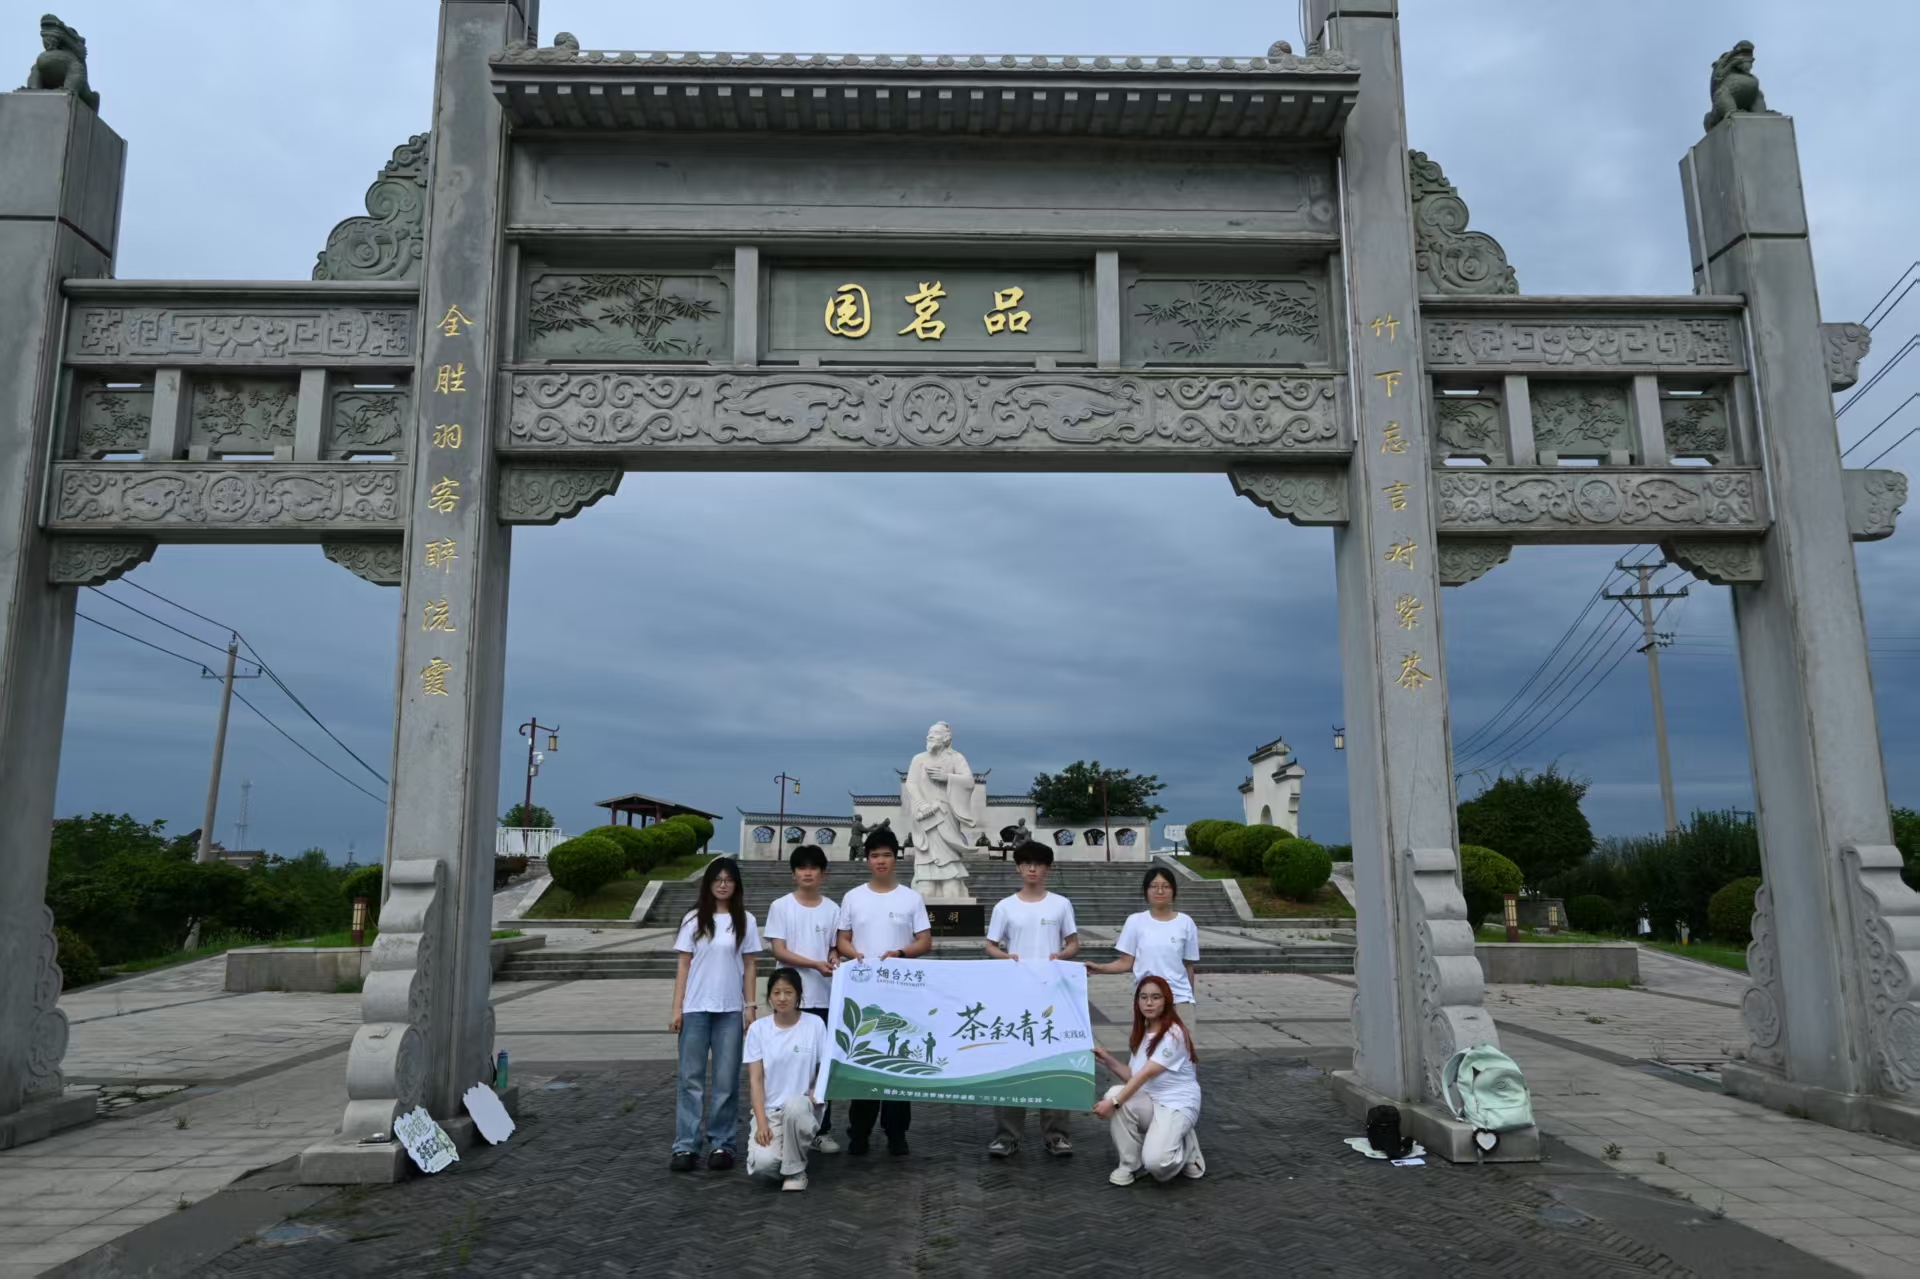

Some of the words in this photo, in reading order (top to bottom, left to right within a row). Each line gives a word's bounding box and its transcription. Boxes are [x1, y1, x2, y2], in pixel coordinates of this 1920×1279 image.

[825, 281, 1032, 340] 品茗园
[419, 304, 474, 697] 全胜羽客醉流霞
[1369, 312, 1433, 692] 竹下忘言对紫茶
[876, 966, 925, 982] 烟台大学
[950, 1002, 1060, 1047] 茶叙青禾
